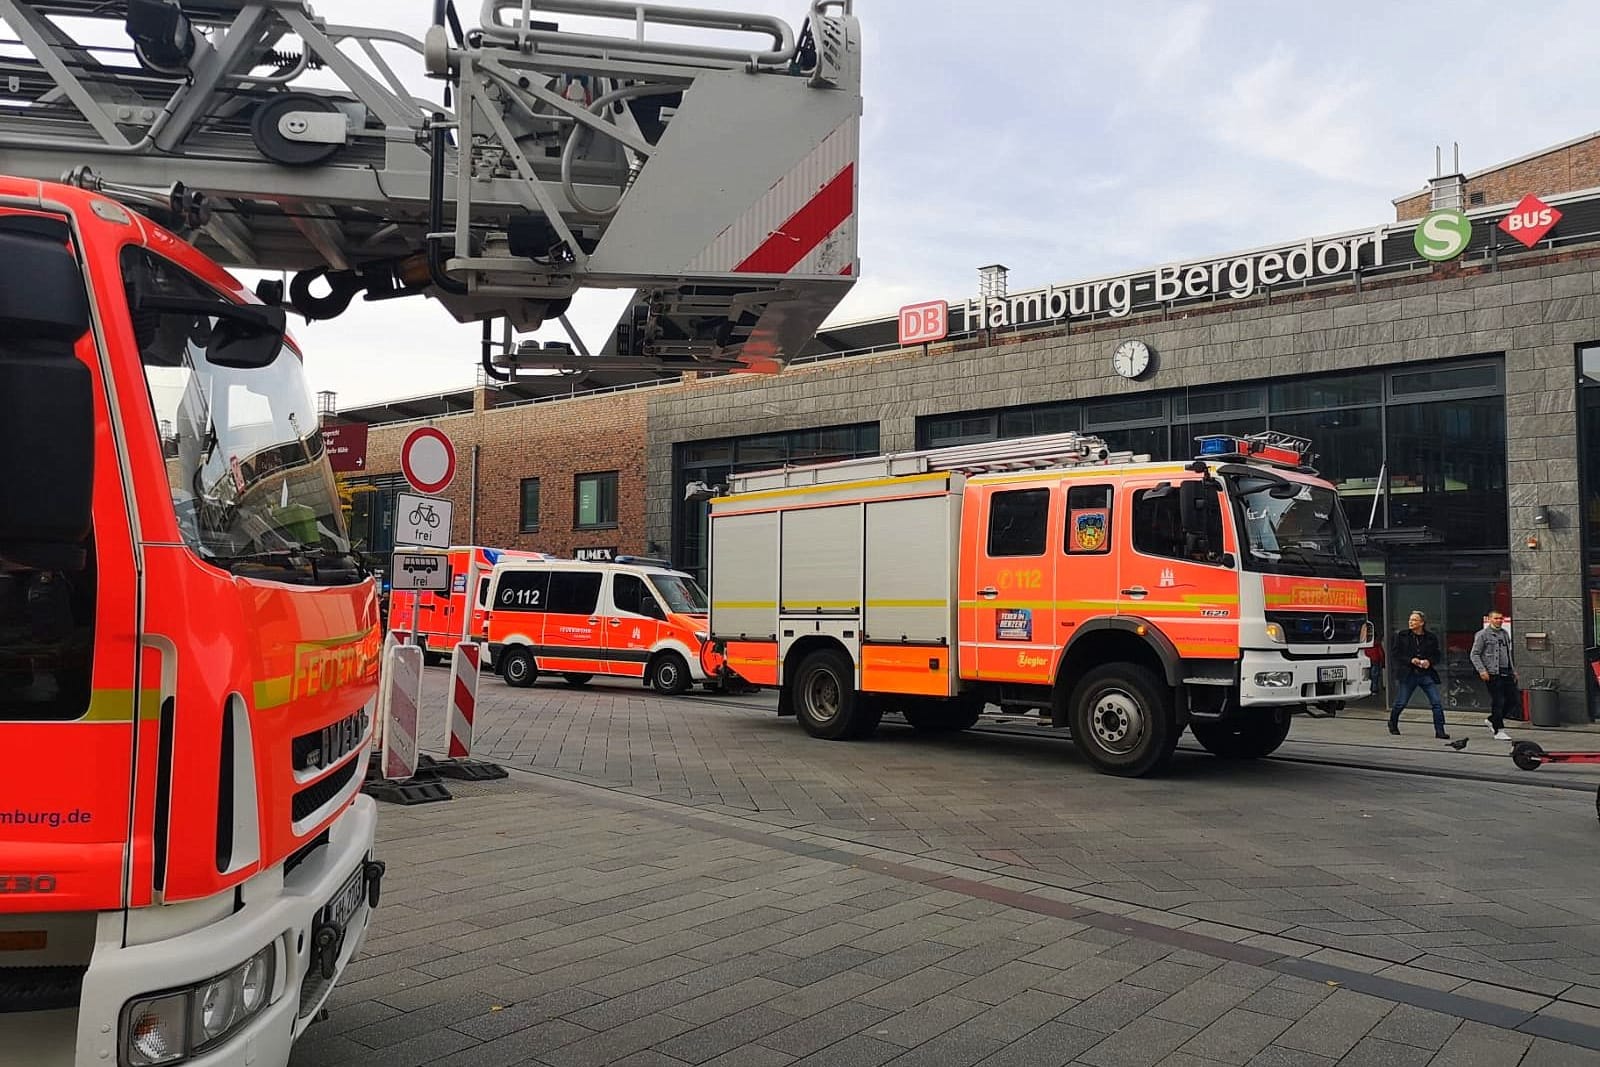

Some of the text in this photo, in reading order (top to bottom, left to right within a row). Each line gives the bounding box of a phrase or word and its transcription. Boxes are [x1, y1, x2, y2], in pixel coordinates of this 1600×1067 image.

[1508, 208, 1553, 231] BUS
[1423, 213, 1462, 257] S
[963, 223, 1388, 331] Hamburg-Bergedorf
[903, 306, 940, 338] DB
[415, 529, 432, 542] frei
[413, 576, 428, 587] frei
[1015, 569, 1042, 589] 112
[516, 589, 540, 605] 112
[1291, 586, 1361, 606] FEUERWEHR
[1201, 609, 1230, 617] 1629
